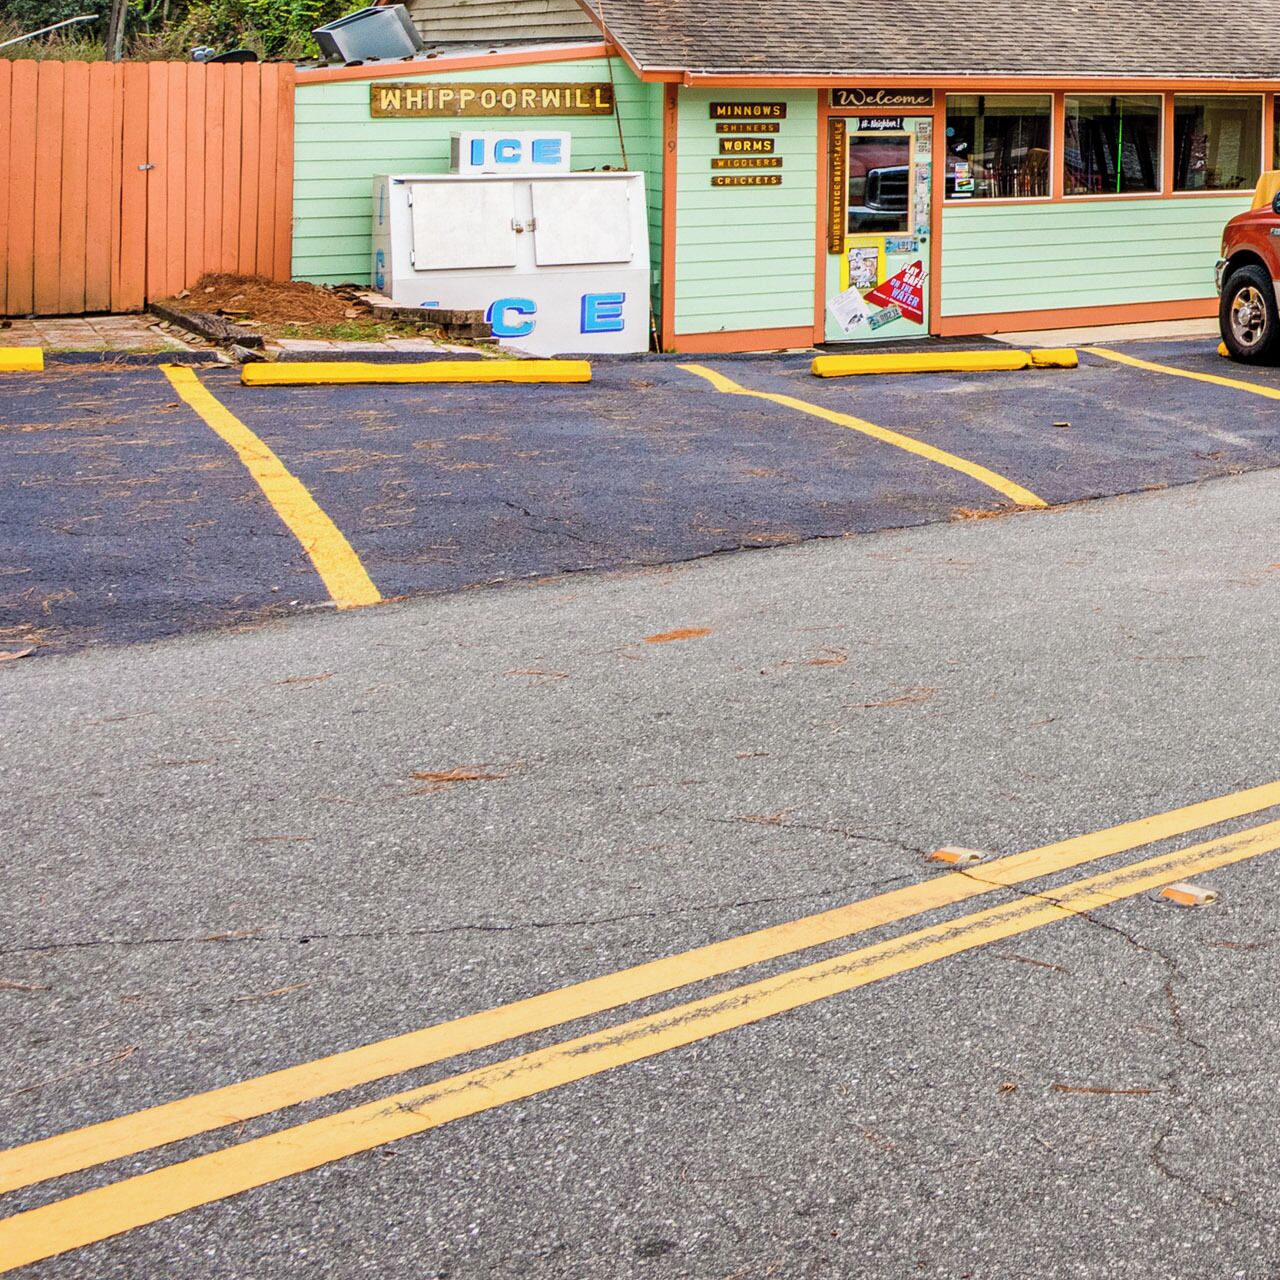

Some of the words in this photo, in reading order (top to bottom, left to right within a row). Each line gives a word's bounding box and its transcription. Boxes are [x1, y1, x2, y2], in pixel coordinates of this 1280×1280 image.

[380, 88, 610, 110] WHIPPOORWILL
[838, 88, 930, 106] Welcome
[717, 105, 780, 116] MINNOWS
[723, 124, 774, 132] SHINERS
[471, 138, 562, 166] ICE
[724, 140, 771, 151] WORMS
[717, 176, 777, 185] CRICKETS
[901, 262, 920, 277] PLAY
[890, 278, 901, 288] ON
[901, 282, 914, 293] THE
[903, 273, 924, 289] SAFE
[891, 288, 920, 308] WATER
